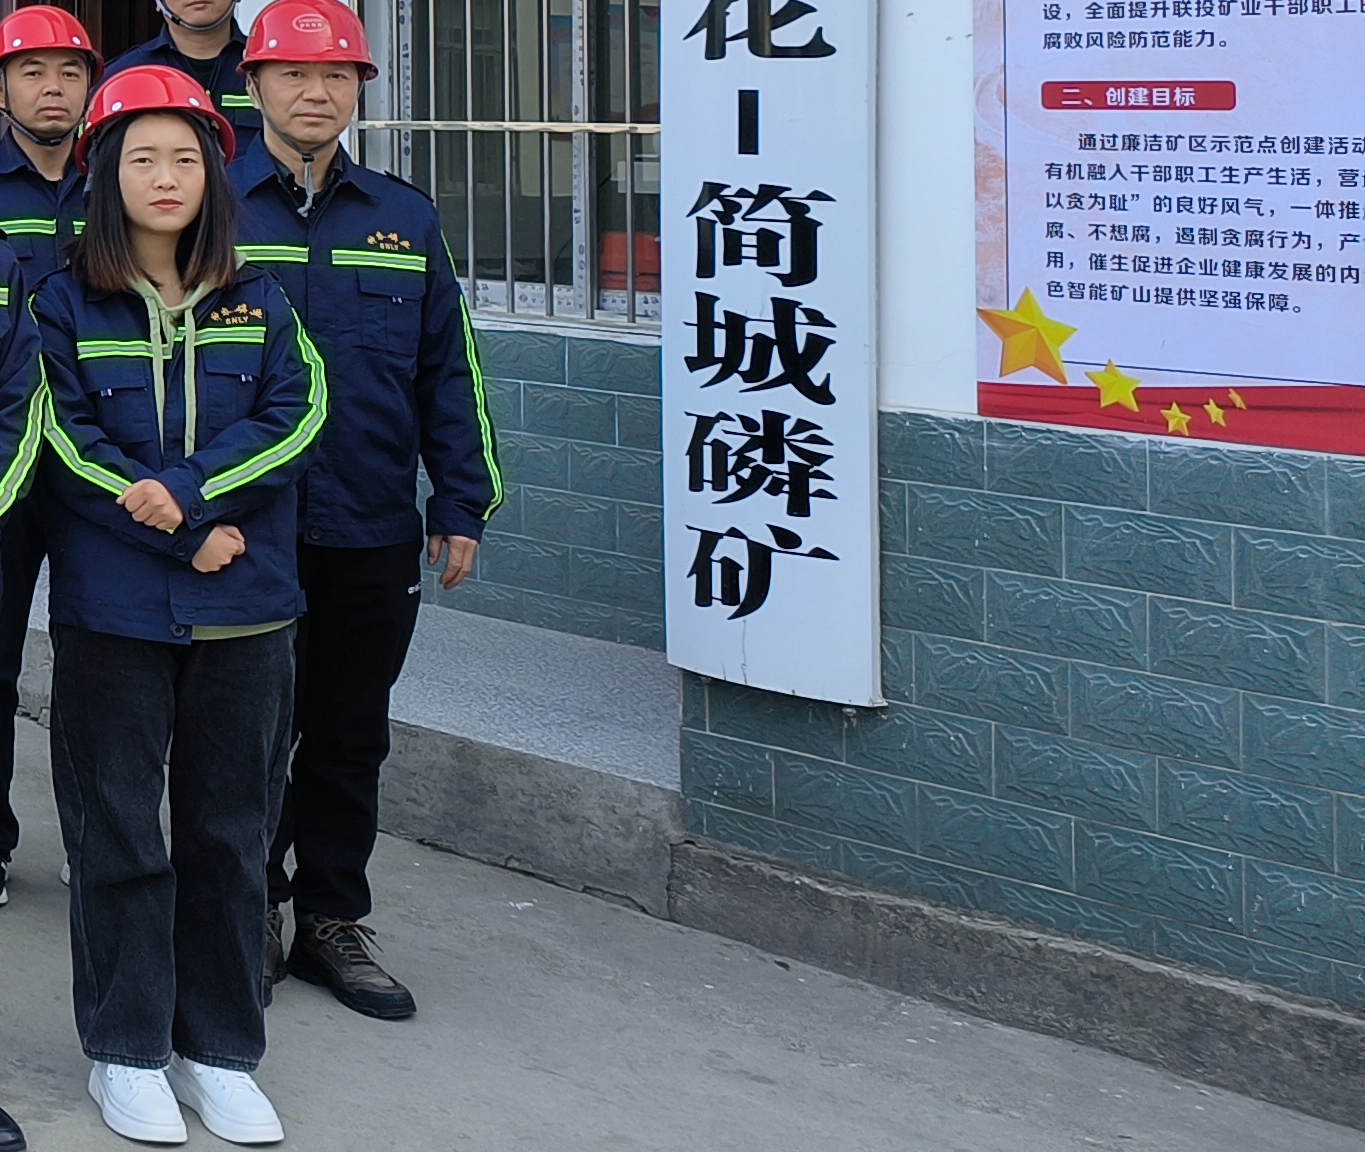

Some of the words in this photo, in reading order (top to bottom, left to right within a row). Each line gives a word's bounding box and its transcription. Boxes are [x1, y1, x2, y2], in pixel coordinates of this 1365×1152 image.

[1061, 86, 1196, 108] 二、创建目标
[1044, 163, 1365, 188] 有机融入干部职工生产生活，营
[1045, 192, 1365, 220] 以贪为耻”的良好风气，一体推
[1045, 221, 1365, 252] 腐、不想腐，遏制贪腐行为，产
